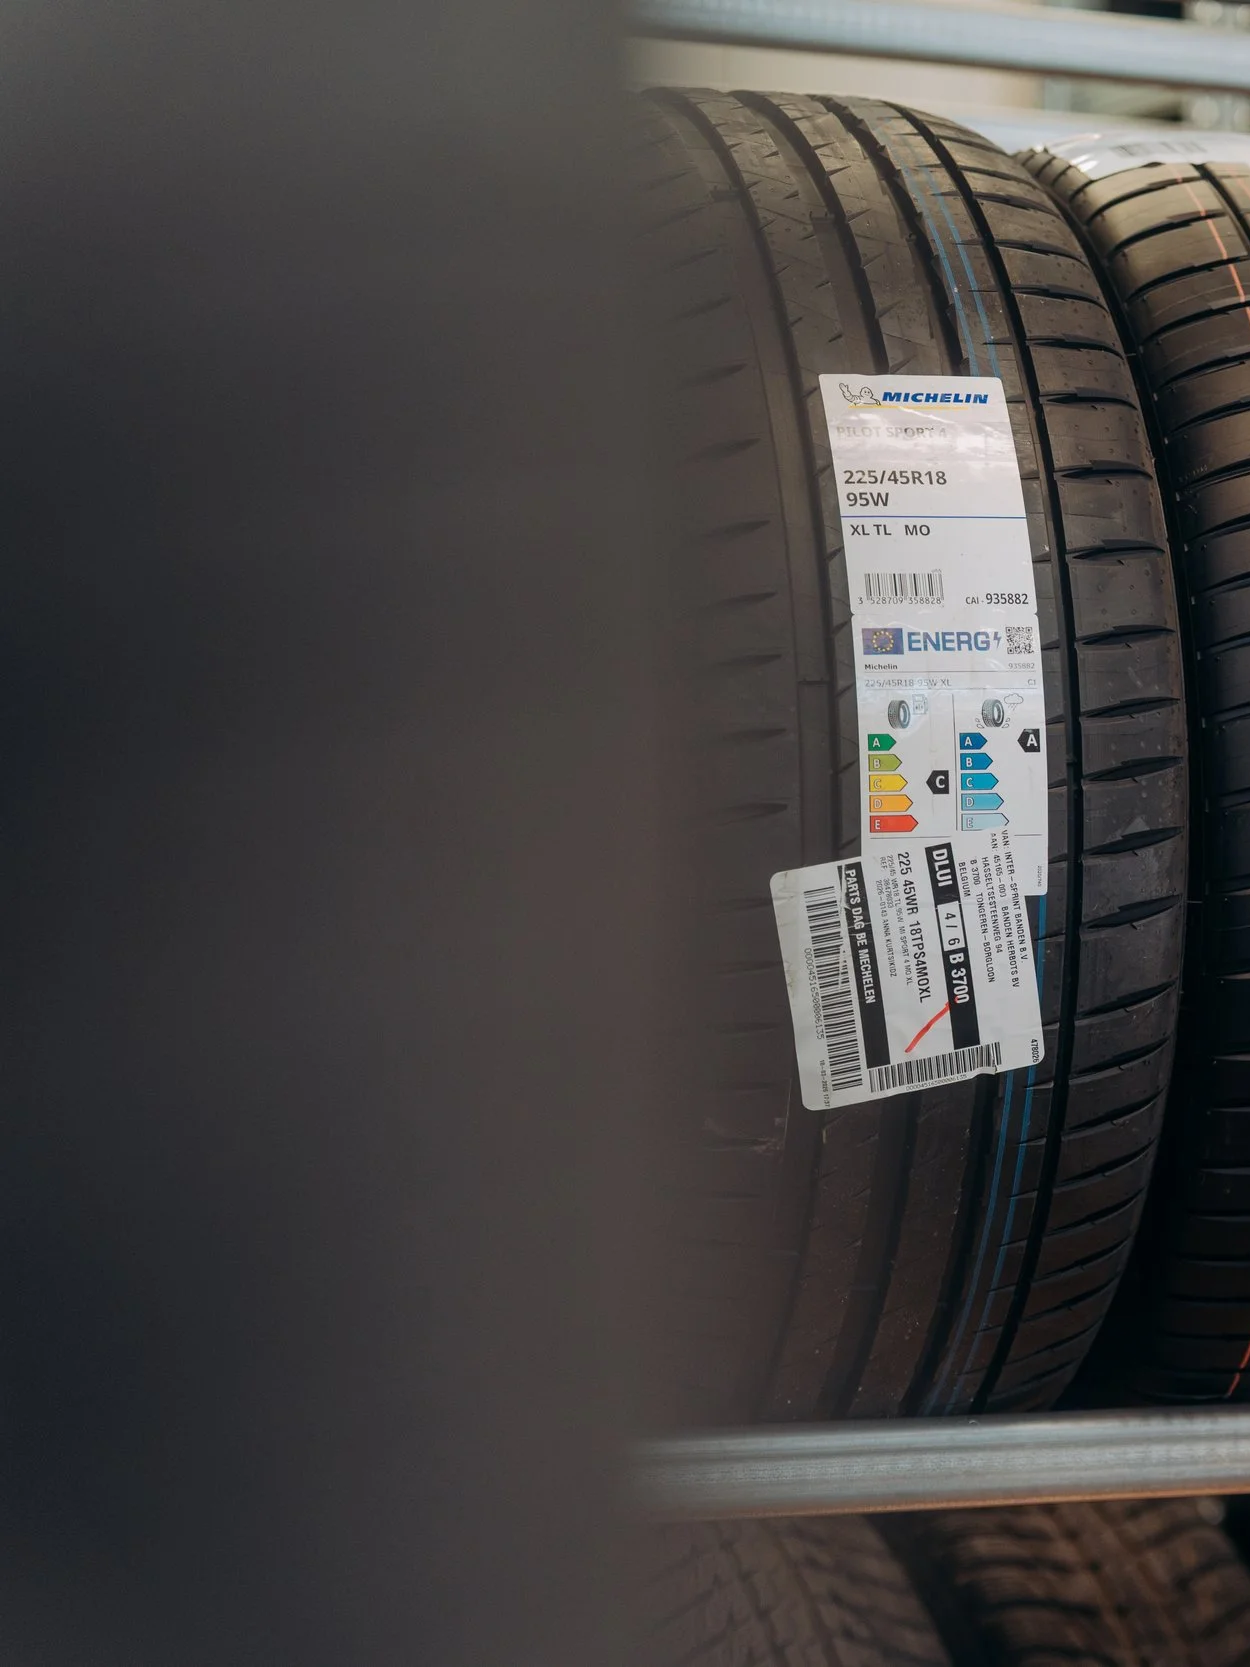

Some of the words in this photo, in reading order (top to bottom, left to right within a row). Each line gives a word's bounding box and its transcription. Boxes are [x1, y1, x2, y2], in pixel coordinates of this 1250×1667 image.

[881, 391, 988, 404] MICHELIN
[836, 426, 881, 438] PILOT
[887, 427, 935, 438] SPORT
[844, 469, 947, 485] 225/45R18
[847, 492, 889, 506] 95W
[851, 524, 870, 536] XL
[874, 524, 892, 535] TL
[905, 524, 930, 536] MO
[966, 596, 979, 604] CAI
[986, 593, 1029, 605] 935882
[908, 632, 990, 651] ENERG
[865, 679, 913, 687] 225/45R18
[872, 736, 881, 748] A
[964, 736, 973, 747] A
[1026, 734, 1037, 747] A
[873, 758, 881, 769] B
[965, 756, 973, 767] B
[873, 778, 881, 789] C
[935, 776, 945, 789] C
[966, 776, 973, 787] C
[873, 798, 882, 809] D
[967, 796, 974, 808] D
[874, 818, 881, 830] E
[967, 816, 974, 829] E
[990, 832, 999, 852] AAN:
[1001, 830, 1010, 849] VAN:
[897, 851, 913, 875] 225
[932, 848, 952, 887] DLUI
[958, 861, 971, 897] BELGIUM
[971, 866, 981, 885] 3700
[845, 869, 861, 905] PARTS
[894, 898, 901, 906] TL
[902, 879, 918, 916] 45WR
[981, 857, 1002, 942] HASSELTSESTEENWEG
[994, 943, 1003, 954] 94
[851, 907, 865, 930] DAG
[895, 908, 904, 923] 95W
[1001, 906, 1013, 938] BANDEN
[881, 919, 891, 937] ANNA
[1014, 913, 1026, 945] BANDEN
[855, 933, 867, 947] BE
[899, 935, 909, 957] SPORT
[949, 953, 962, 964] B
[1006, 940, 1018, 976] HERBOTS
[1019, 947, 1029, 963] B.V.
[858, 949, 876, 1004] MECHELEN
[906, 977, 913, 985] XL
[1012, 977, 1020, 988] BV
[951, 968, 970, 1004] 3700
[1030, 1038, 1040, 1063] 478026
